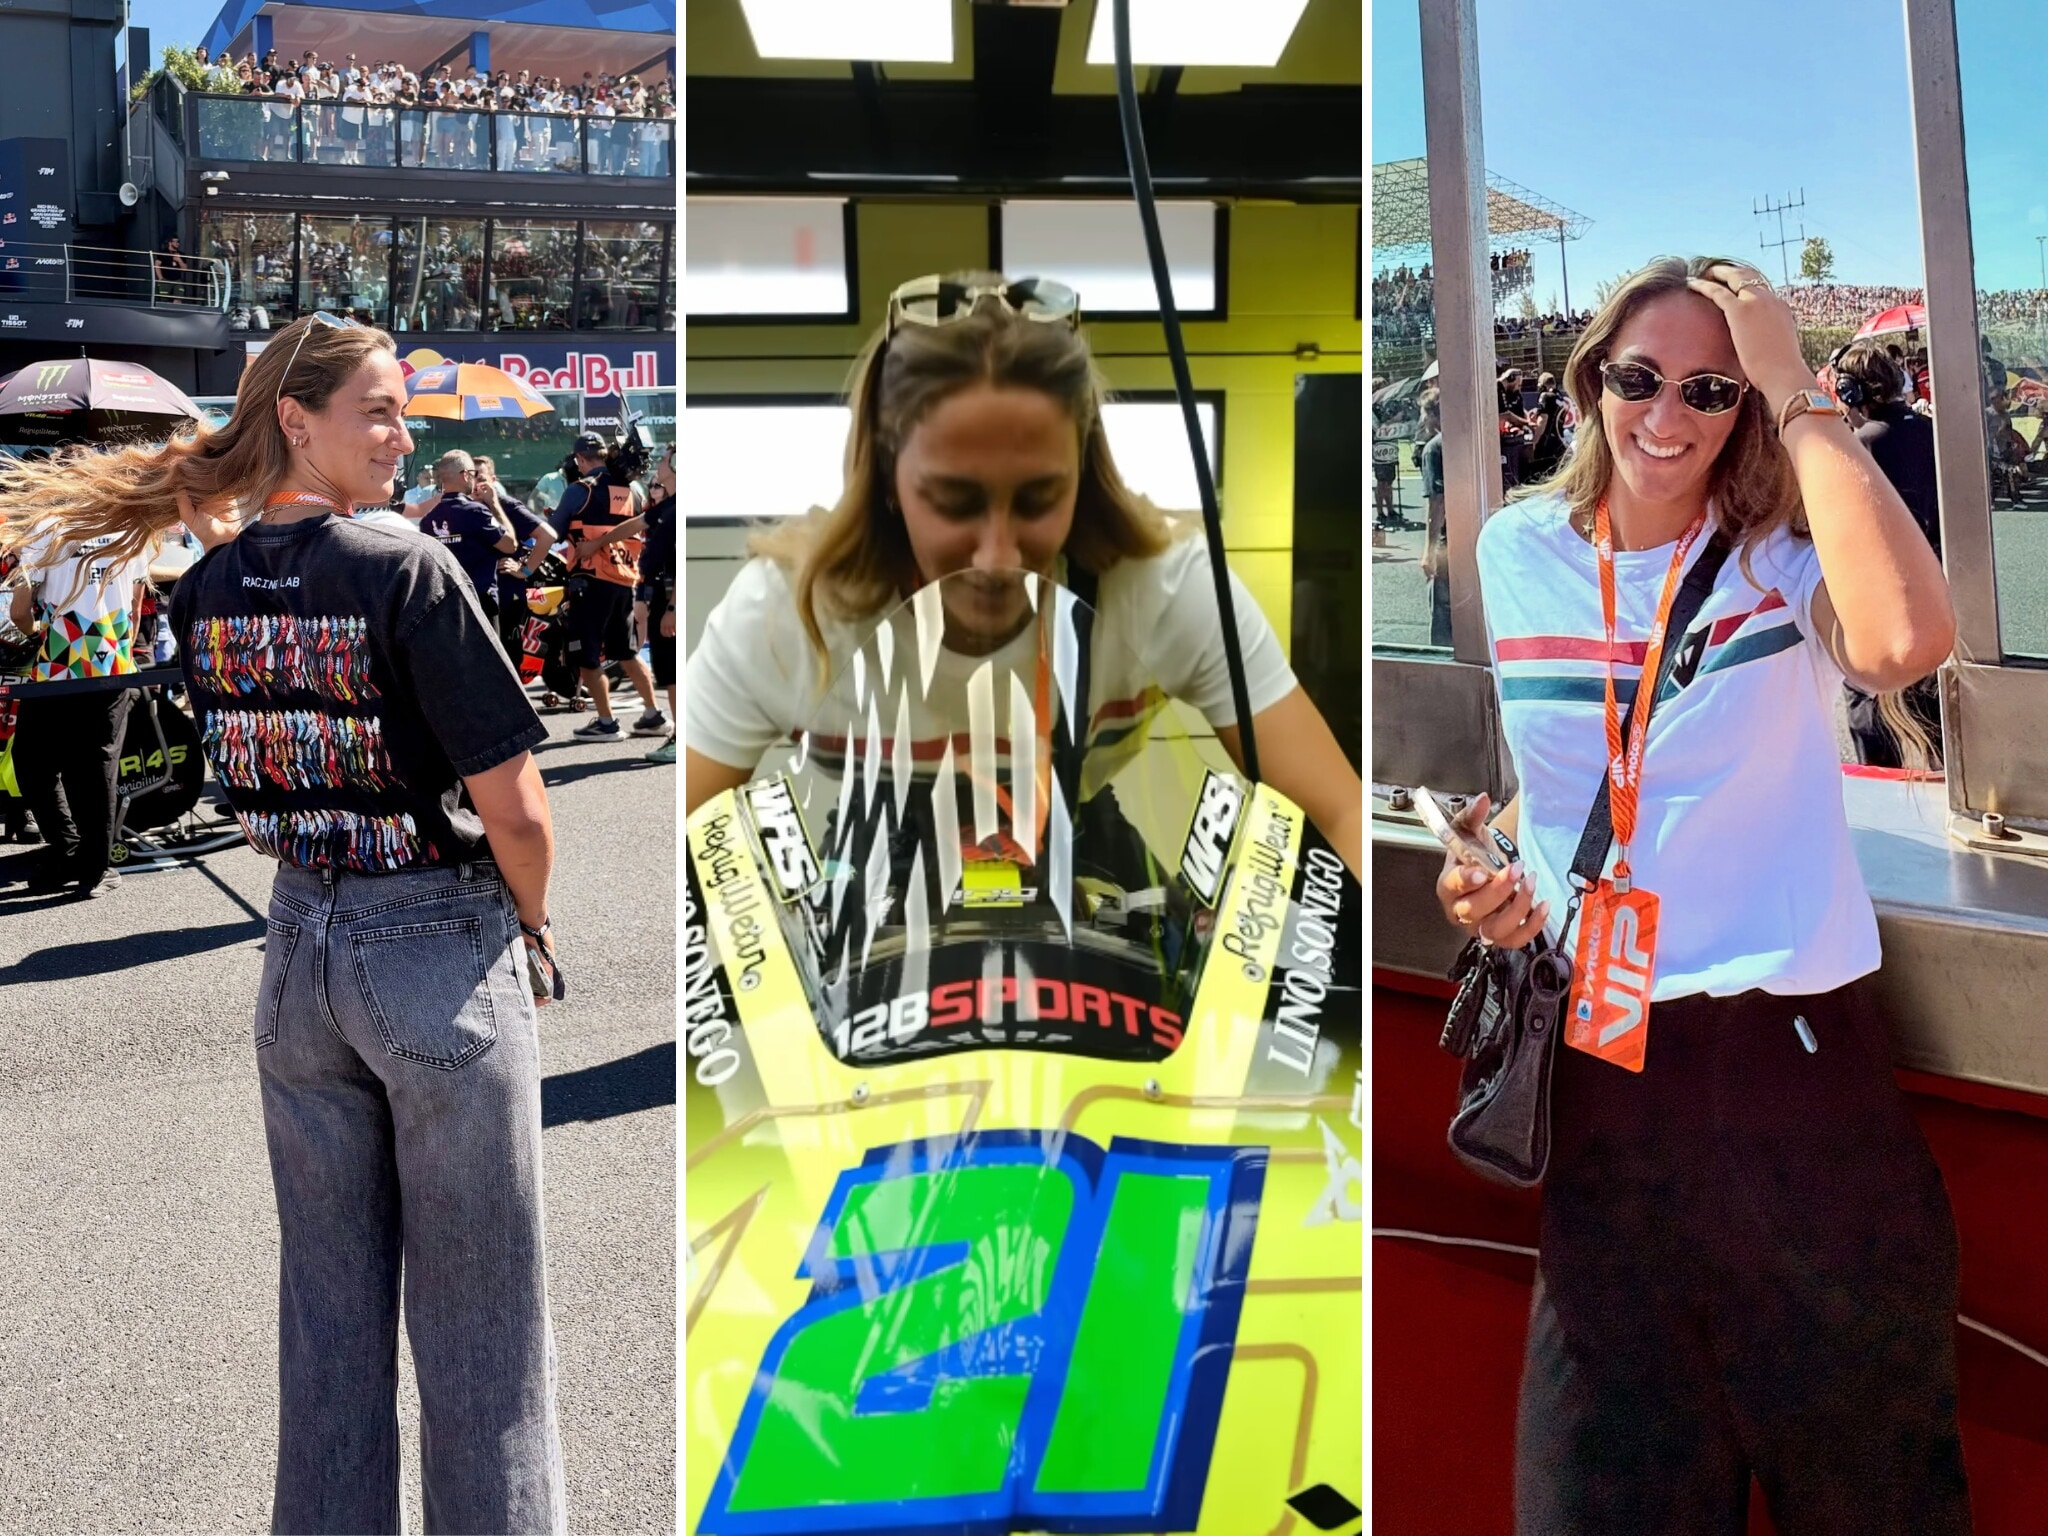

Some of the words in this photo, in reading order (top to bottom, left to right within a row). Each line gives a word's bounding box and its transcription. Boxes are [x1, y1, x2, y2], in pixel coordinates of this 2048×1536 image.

[18, 392, 68, 403] MONSTER
[501, 352, 579, 390] Red
[583, 350, 659, 397] Bull
[279, 576, 300, 588] LAB
[1611, 754, 1625, 788] VIP
[1292, 847, 1345, 985] SONEGO
[1597, 904, 1650, 1048] VIP
[1267, 967, 1327, 1079] LINO
[695, 1128, 1271, 1535] 21
